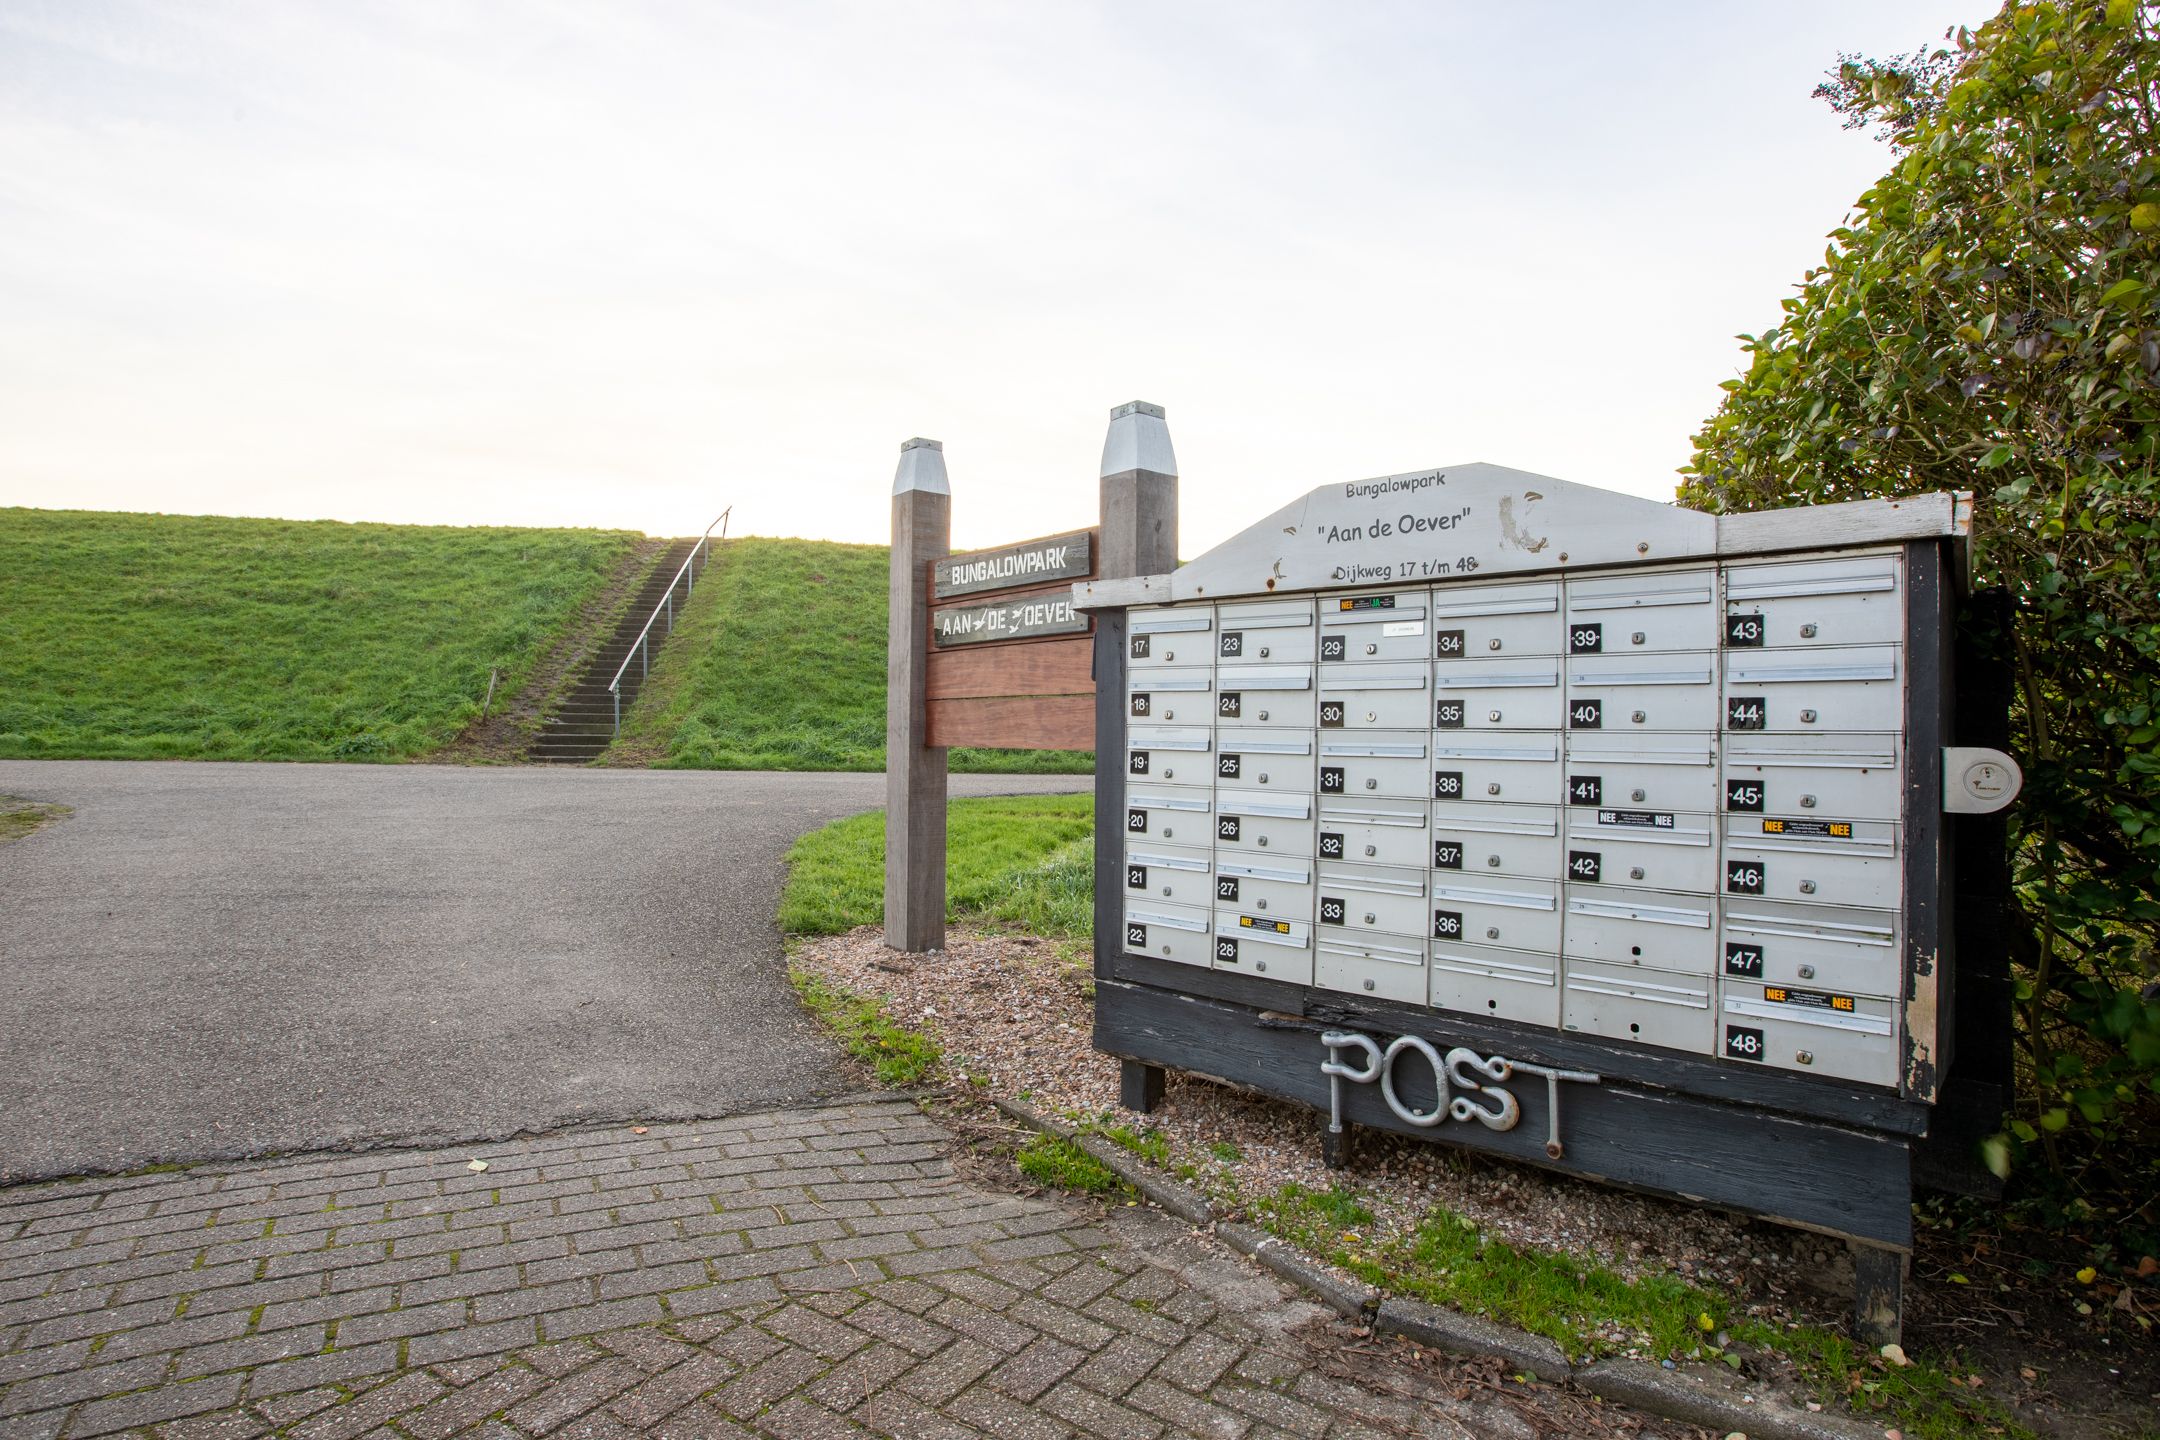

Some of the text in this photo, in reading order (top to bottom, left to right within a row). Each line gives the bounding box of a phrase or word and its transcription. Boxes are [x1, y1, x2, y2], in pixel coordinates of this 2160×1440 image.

[1346, 472, 1446, 499] Bungalowpark
[1318, 507, 1471, 544] "Aan de Oever"
[952, 546, 1067, 586] BUNGALOWPARK
[1336, 556, 1475, 583] Dijkweg 17 t/m 48
[1341, 600, 1354, 610] NEE
[1372, 598, 1381, 608] JA
[942, 614, 971, 636] AAN
[988, 610, 1006, 630] DE
[1732, 622, 1757, 639] 43
[1224, 638, 1238, 651] 23
[1441, 636, 1459, 651] 34
[1575, 630, 1595, 646] 39
[1134, 640, 1145, 652] 17
[1325, 641, 1340, 655] 29
[1134, 698, 1145, 710] 18
[1222, 698, 1236, 711] 24
[1323, 707, 1339, 721] 30
[1441, 706, 1459, 720] 35
[1575, 706, 1596, 722] 40
[1734, 705, 1759, 721] 44
[1133, 756, 1144, 768] 19
[1222, 759, 1236, 773] 25
[1325, 773, 1338, 787] 31
[1439, 778, 1457, 792] 38
[1576, 783, 1594, 798] 41
[1733, 787, 1758, 804] 45
[1131, 814, 1143, 827] 20
[1600, 812, 1616, 823] NEE
[1655, 815, 1672, 826] NEE
[1221, 821, 1235, 835] 26
[1764, 820, 1784, 833] NEE
[1830, 824, 1850, 836] NEE
[1323, 838, 1338, 853] 32
[1439, 847, 1457, 862] 37
[1573, 858, 1594, 875] 42
[1131, 871, 1142, 883] 21
[1733, 869, 1758, 886] 46
[1220, 882, 1234, 895] 27
[1324, 903, 1340, 918] 33
[1241, 917, 1252, 927] NEE
[1277, 923, 1289, 932] NEE
[1439, 917, 1457, 933] 36
[1130, 928, 1142, 942] 22
[1220, 943, 1234, 957] 28
[1731, 951, 1756, 969] 47
[1766, 988, 1785, 1001] NEE
[1833, 997, 1853, 1010] NEE
[1731, 1034, 1756, 1053] 48
[1321, 1031, 1600, 1160] POST
